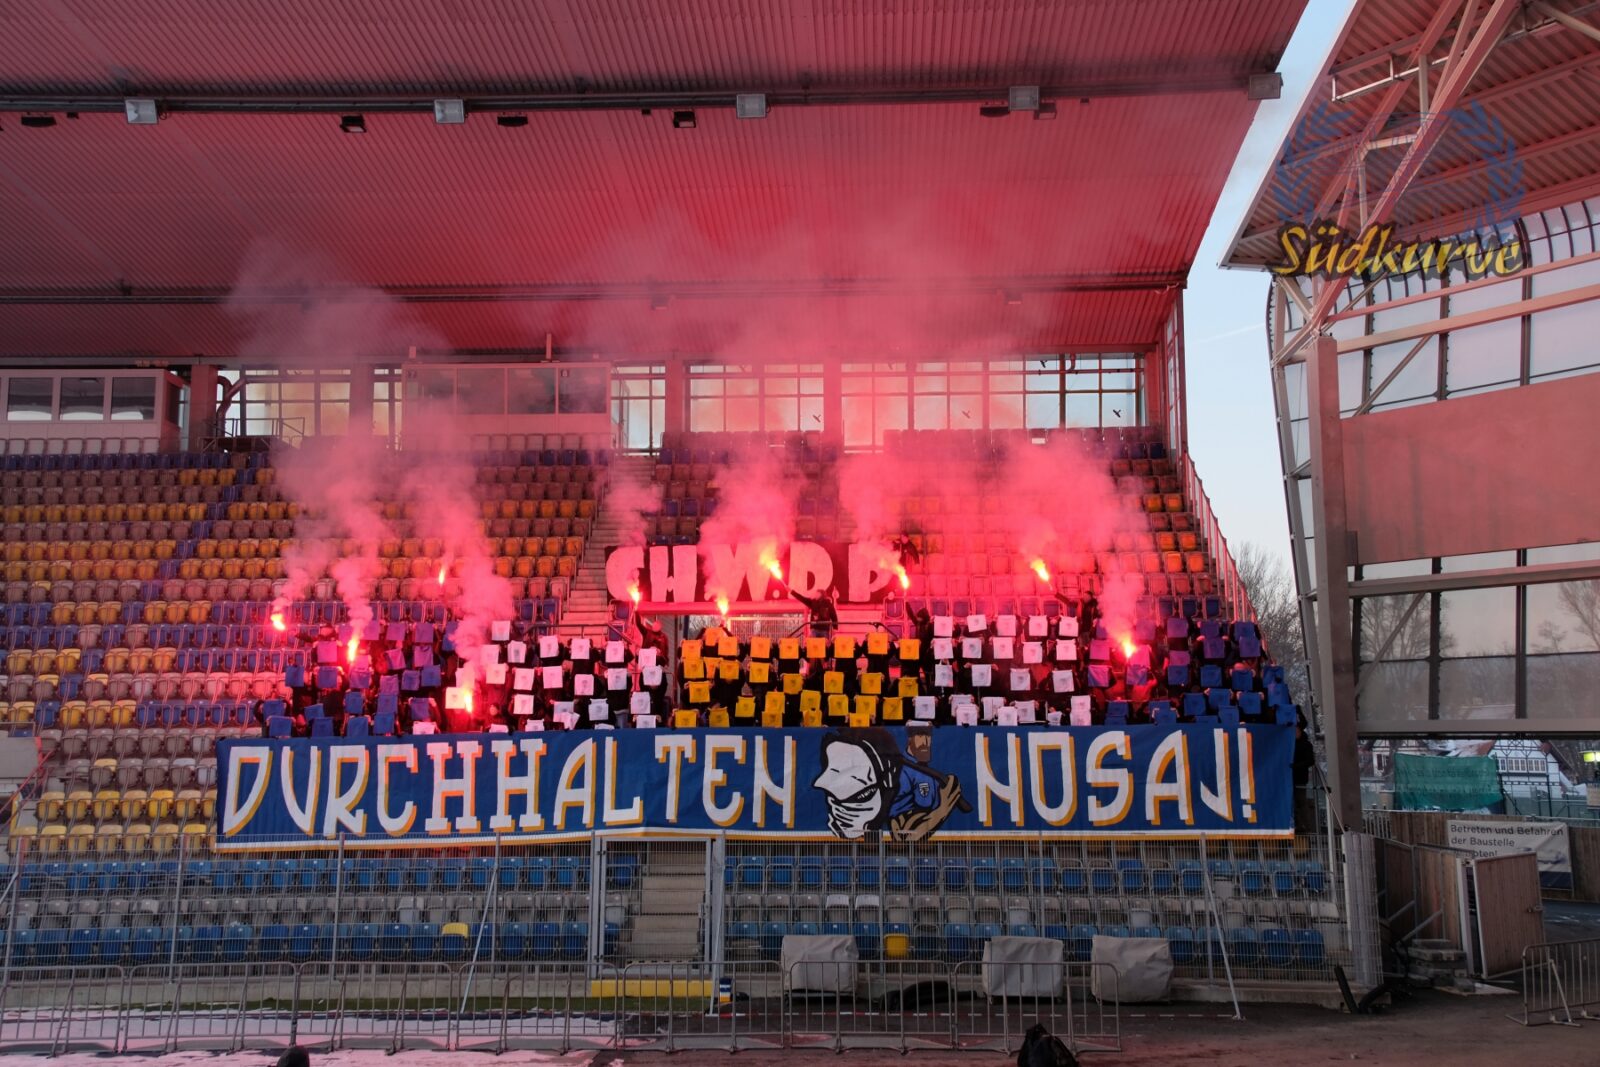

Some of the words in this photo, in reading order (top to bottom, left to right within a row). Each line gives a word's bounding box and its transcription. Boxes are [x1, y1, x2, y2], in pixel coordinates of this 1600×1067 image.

[223, 734, 797, 838] DURCHHALTEN
[975, 727, 1257, 827] NOSAJ!
[1450, 824, 1495, 834] Betreten
[1495, 826, 1514, 835] und
[1451, 836, 1467, 845] der
[1470, 837, 1515, 847] Baustelle
